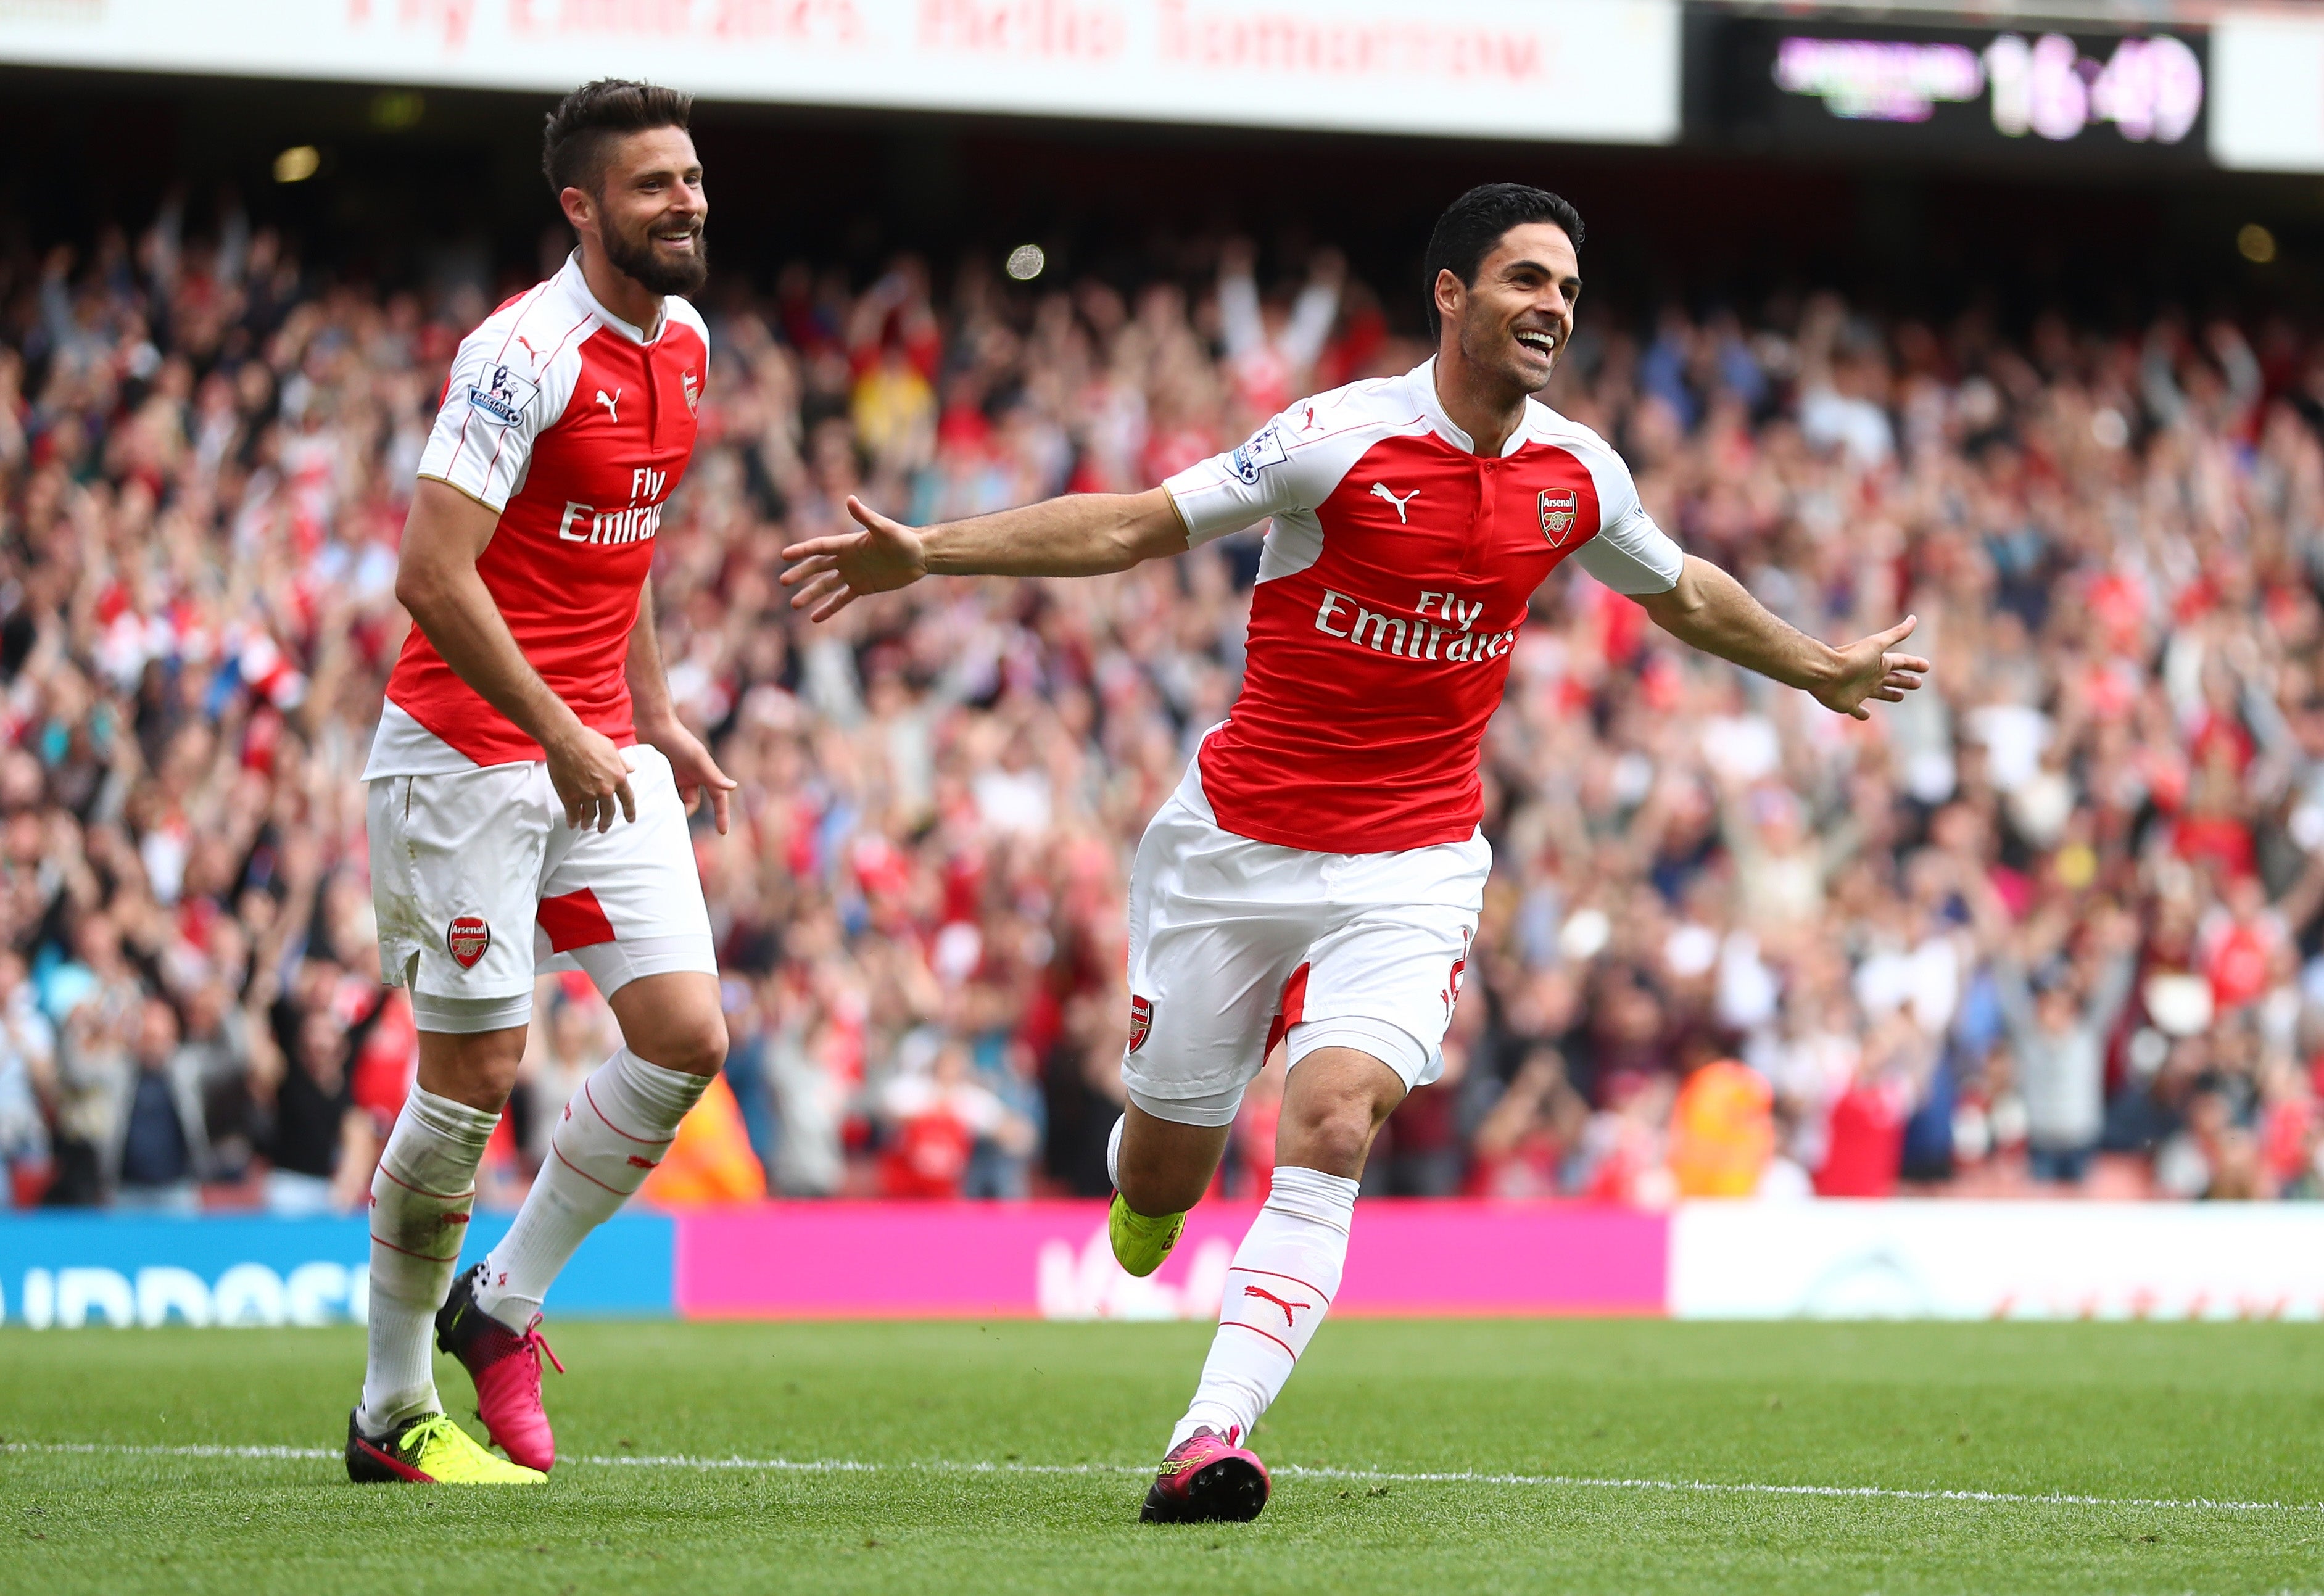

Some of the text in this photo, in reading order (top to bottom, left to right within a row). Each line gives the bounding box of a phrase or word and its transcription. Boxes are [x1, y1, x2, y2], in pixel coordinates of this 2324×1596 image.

[631, 466, 666, 502] Fly
[1544, 497, 1573, 507] Arsenal
[1415, 590, 1484, 632] Fly
[453, 925, 484, 934] Arsenal
[1133, 1007, 1148, 1017] senal
